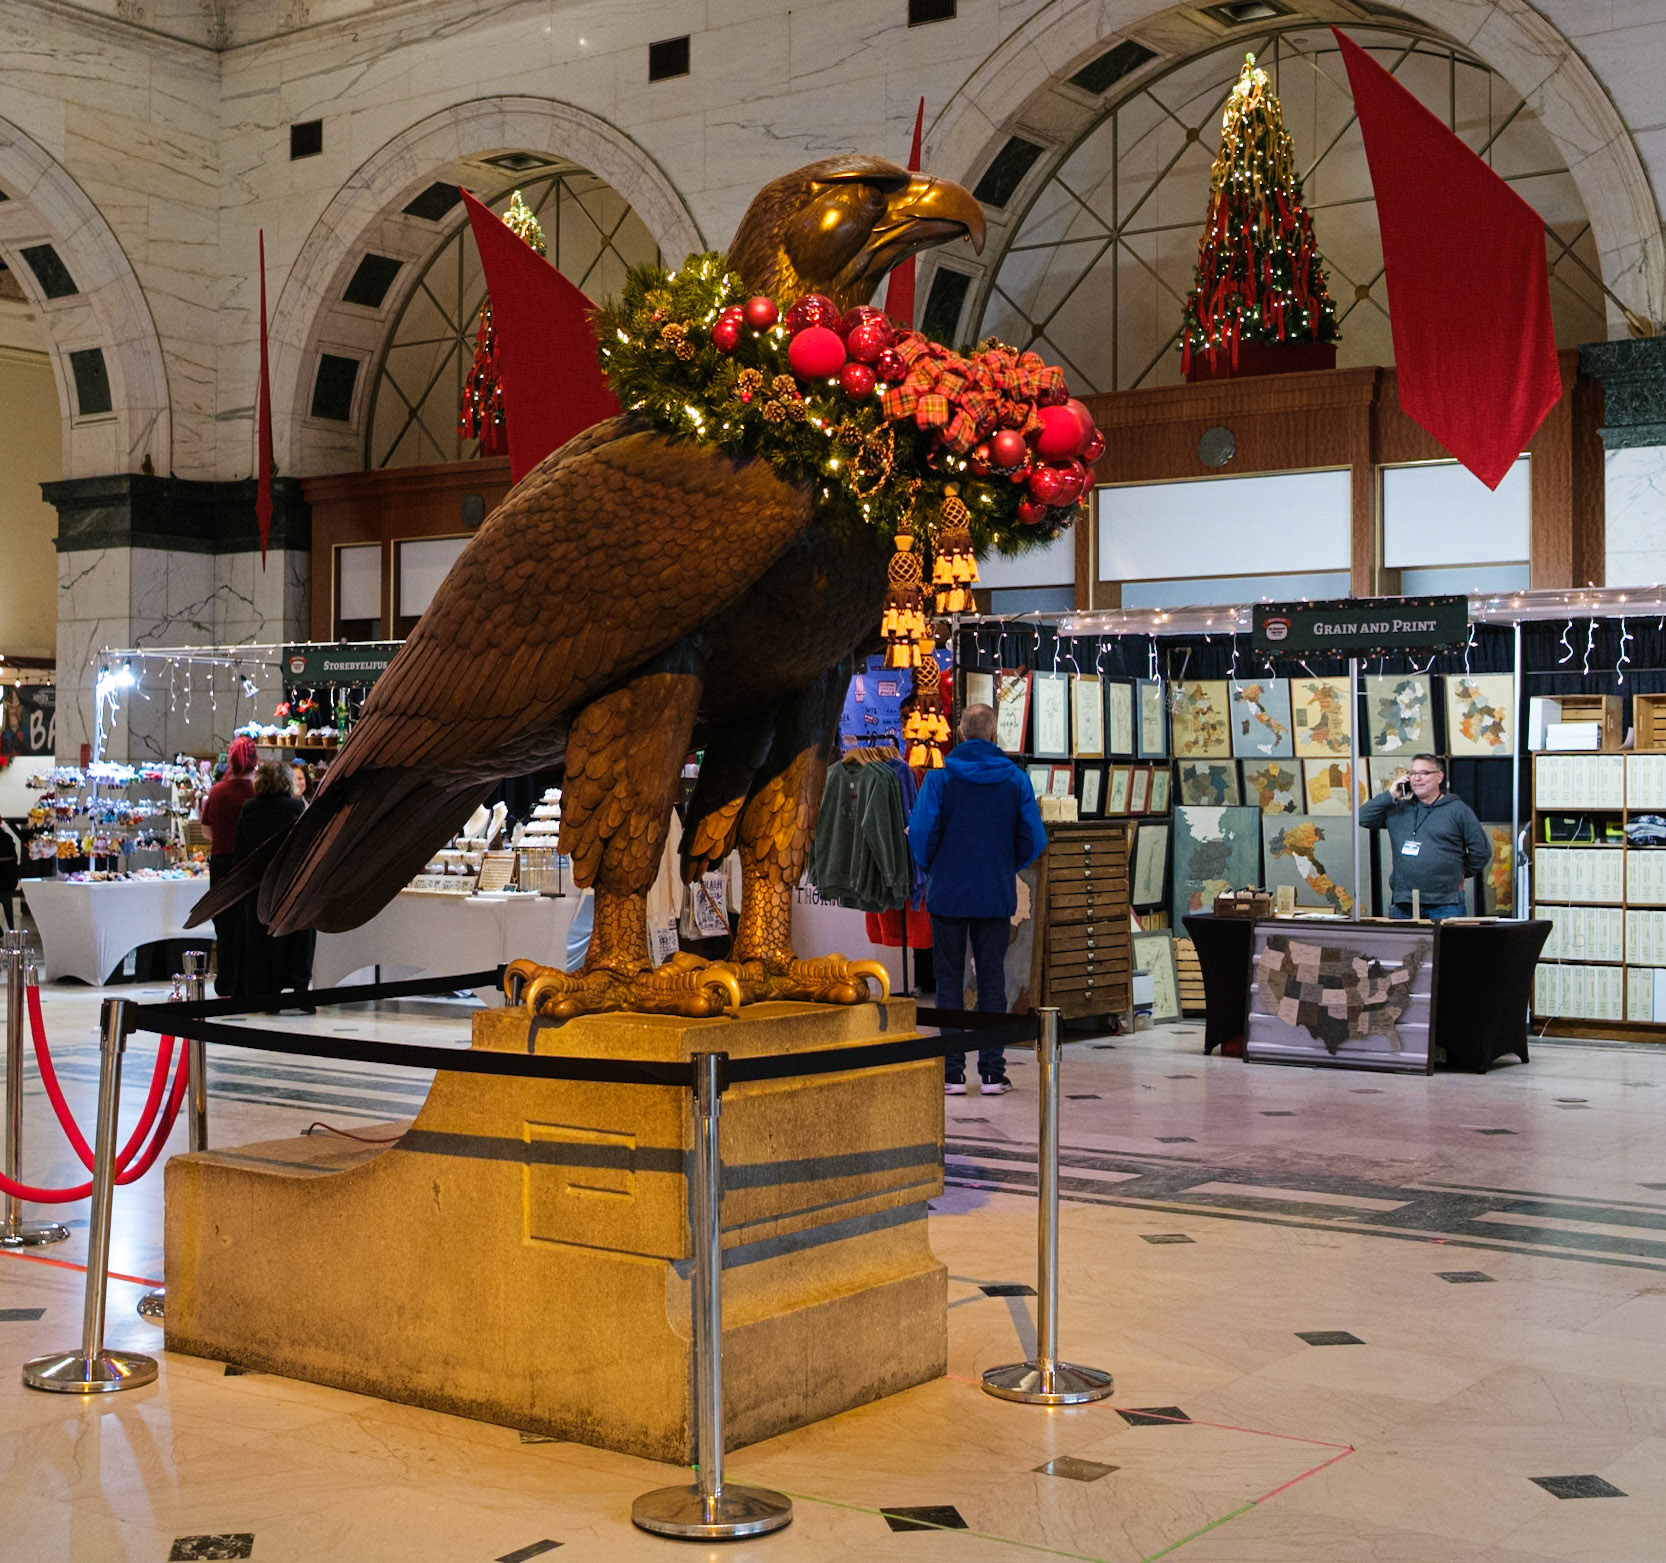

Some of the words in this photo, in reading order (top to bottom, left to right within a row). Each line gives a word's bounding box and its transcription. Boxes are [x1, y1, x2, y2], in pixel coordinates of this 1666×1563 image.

[1313, 621, 1357, 636] GRAIN
[1360, 620, 1390, 634] AND
[1392, 618, 1437, 633] PRINT
